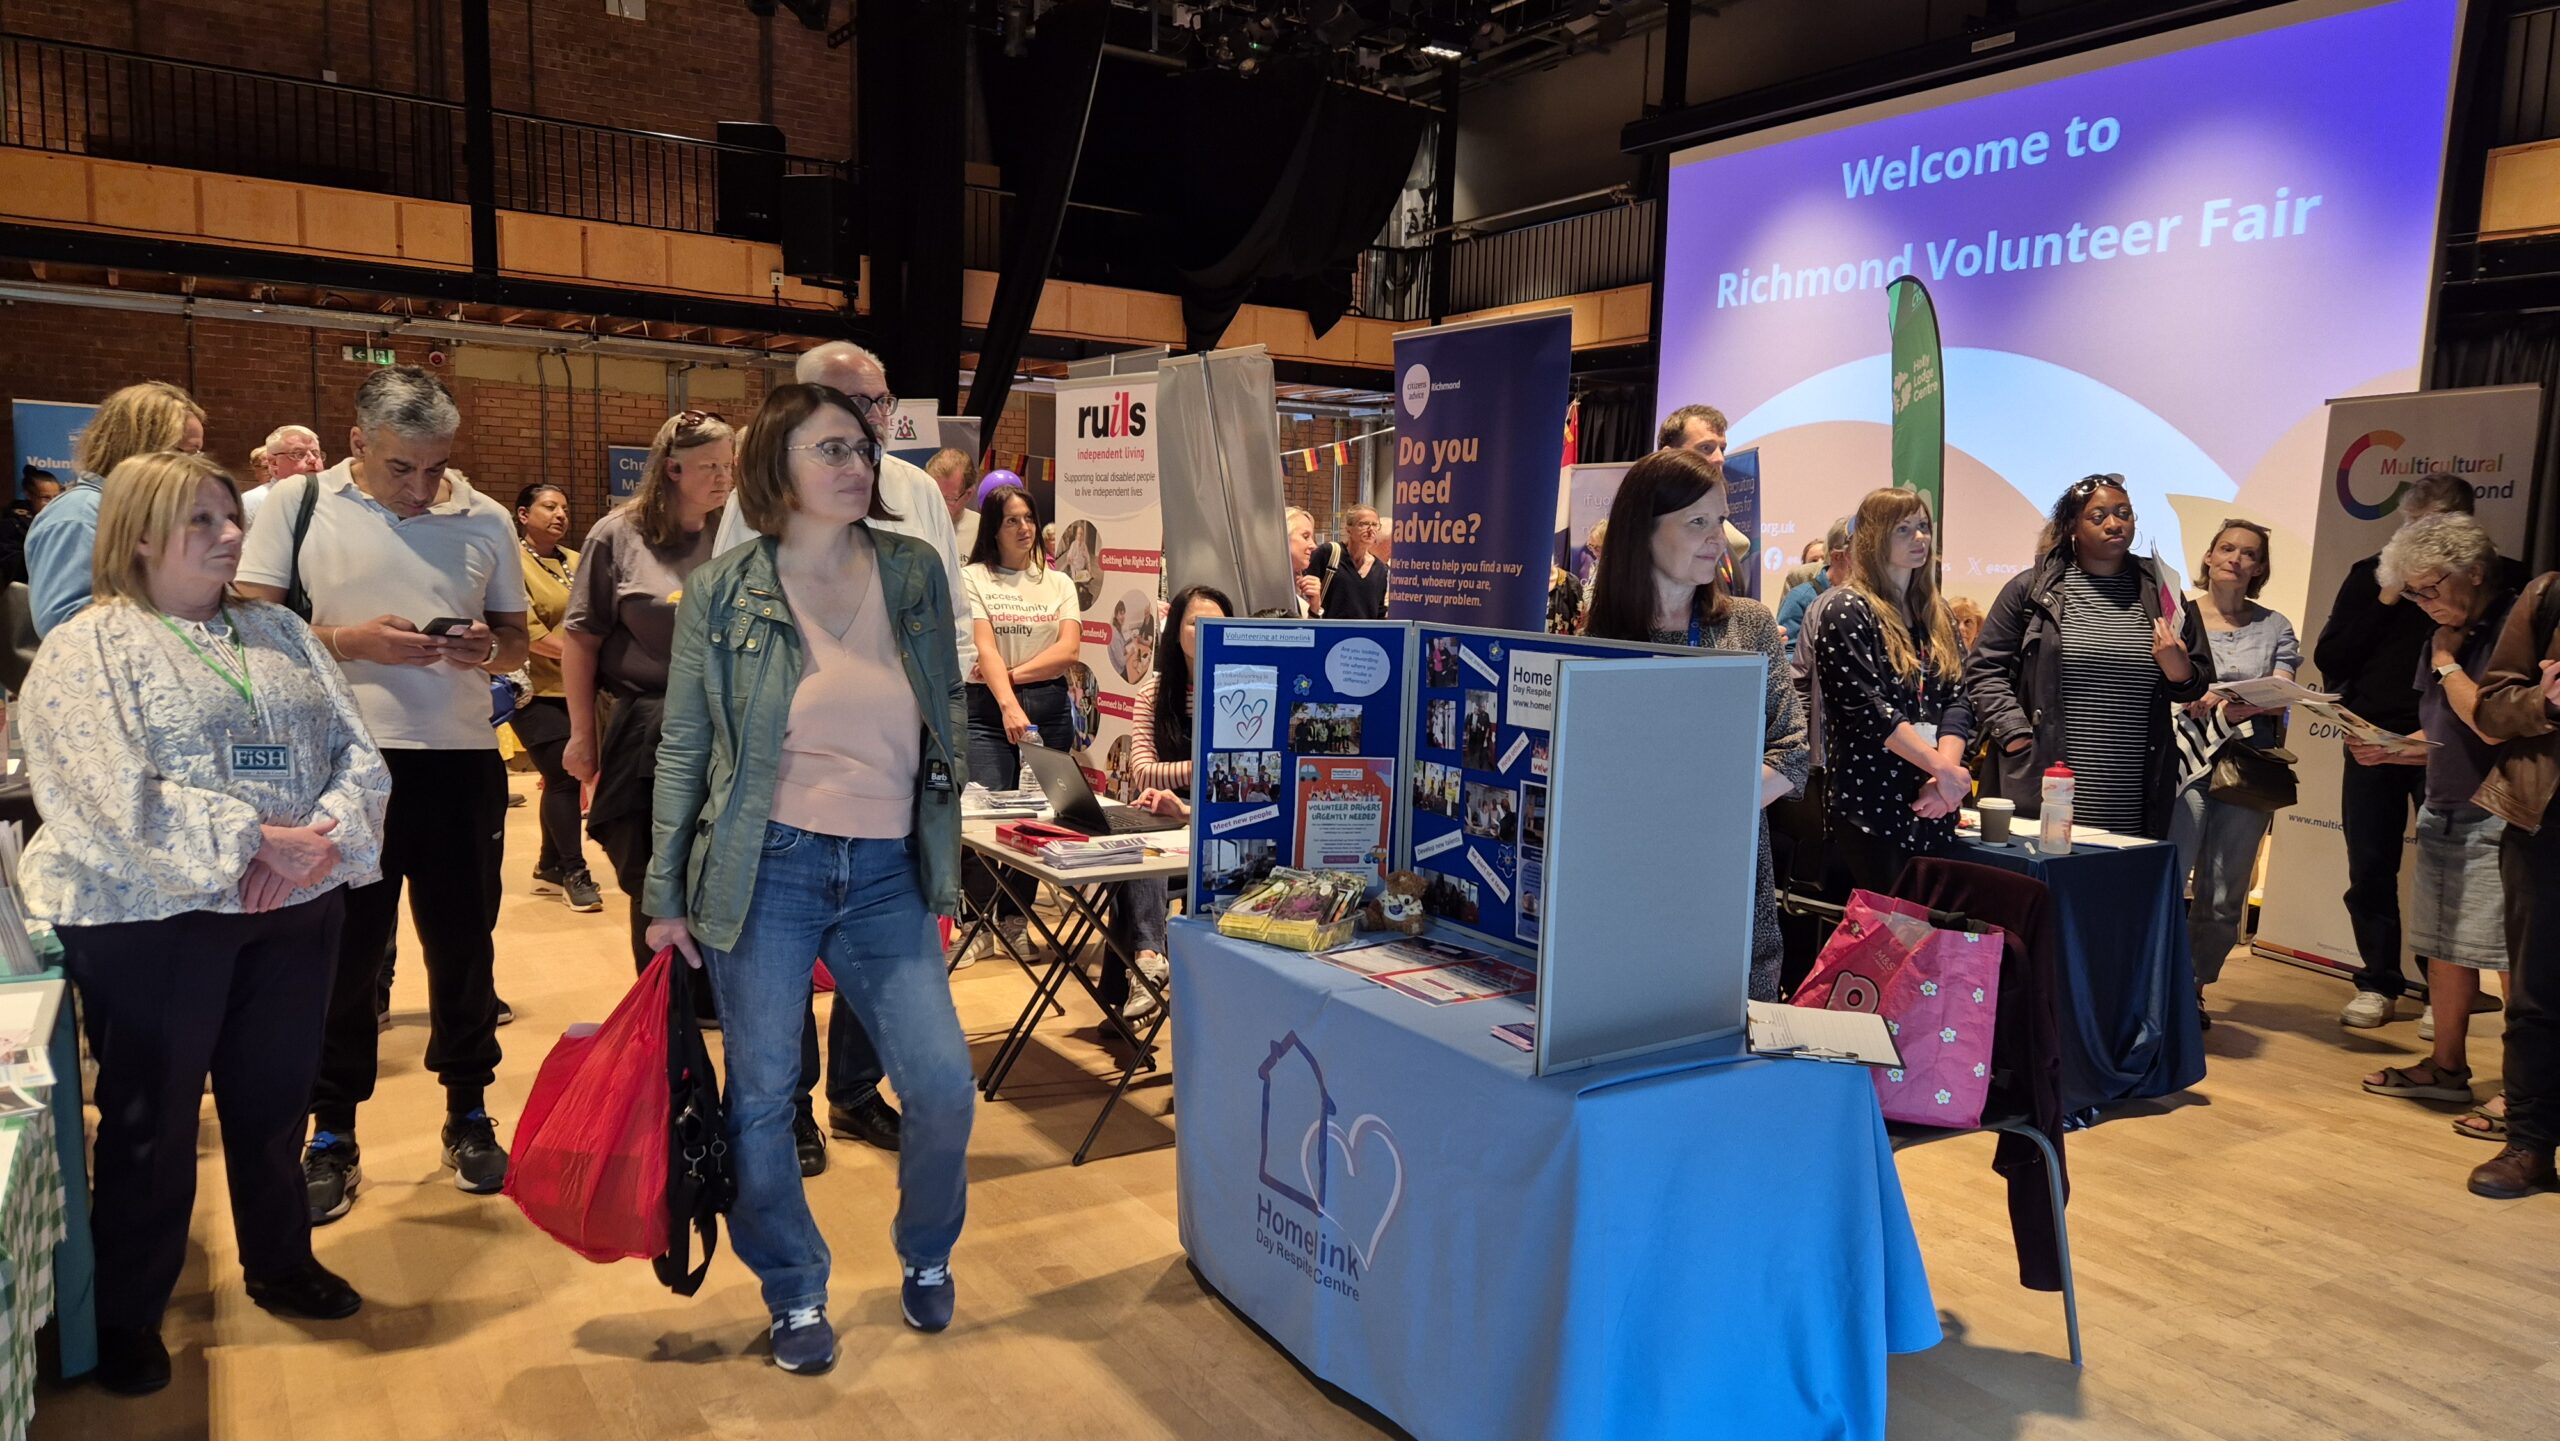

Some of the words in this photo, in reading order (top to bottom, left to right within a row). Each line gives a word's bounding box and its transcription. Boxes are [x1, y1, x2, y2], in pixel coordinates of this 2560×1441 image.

[1841, 129, 2050, 199] Welcome
[2065, 114, 2121, 159] to
[1716, 242, 1914, 308] Richmond
[1925, 213, 2183, 281] Volunteer
[2200, 186, 2323, 248] Fair
[1913, 353, 1932, 374] Holly
[1913, 367, 1935, 388] Lodge
[1407, 381, 1427, 391] citizens
[1431, 380, 1461, 392] Richmond
[1913, 380, 1939, 403] Centre
[1408, 391, 1425, 401] advice
[1078, 390, 1147, 439] ruils
[26, 456, 74, 469] Volun
[1077, 448, 1123, 463] independent
[1125, 447, 1145, 462] living
[1398, 436, 1426, 466] Do
[1431, 437, 1480, 473] you
[2380, 453, 2504, 476] Multicultural
[1063, 472, 1094, 486] Supporting
[1095, 472, 1109, 483] local
[1110, 472, 1136, 482] disabled
[1136, 471, 1156, 484] people
[1074, 487, 1080, 497] to
[1081, 486, 1092, 497] live
[1092, 486, 1130, 498] independent
[1130, 486, 1144, 497] lives
[1396, 471, 1452, 505] need
[1393, 511, 1483, 545] advice?
[1101, 553, 1123, 568] Getting
[1123, 554, 1132, 567] the
[1131, 555, 1145, 569] Right
[1145, 555, 1159, 568] Start
[1391, 558, 1410, 570] We're
[1410, 559, 1431, 570] here
[1431, 560, 1441, 571] to
[1441, 559, 1460, 574] help
[1461, 562, 1478, 575] you
[1479, 561, 1495, 573] find
[1496, 563, 1502, 573] a
[1502, 563, 1523, 577] way
[1422, 576, 1456, 588] whoever
[1457, 578, 1475, 590] you
[1476, 580, 1492, 592] are,
[985, 592, 1024, 602] access
[1390, 590, 1423, 602] whatever
[1424, 593, 1443, 606] your
[1443, 594, 1483, 607] problem.
[987, 602, 1048, 613] community
[989, 612, 1059, 624] ndependen
[994, 624, 1033, 637] quality
[1225, 632, 1270, 641] Volunteering
[1271, 633, 1279, 641] at
[1280, 633, 1311, 642] Homelink
[1513, 665, 1553, 686] Home
[1512, 684, 1526, 695] Day
[1526, 687, 1552, 698] Respite
[1096, 696, 1118, 710] Connect
[931, 772, 948, 781] Barb
[1308, 803, 1349, 811] VOLUNTEER
[1213, 820, 1232, 831] Meet
[1232, 816, 1248, 825] new
[1248, 810, 1273, 822] people
[1311, 812, 1347, 820] URGENTLY
[1348, 812, 1377, 820] NEEDED
[1256, 1192, 1360, 1282] Homelink
[1256, 1229, 1275, 1256] Day
[1275, 1240, 1313, 1279] Respite
[1313, 1267, 1360, 1302] Centre
